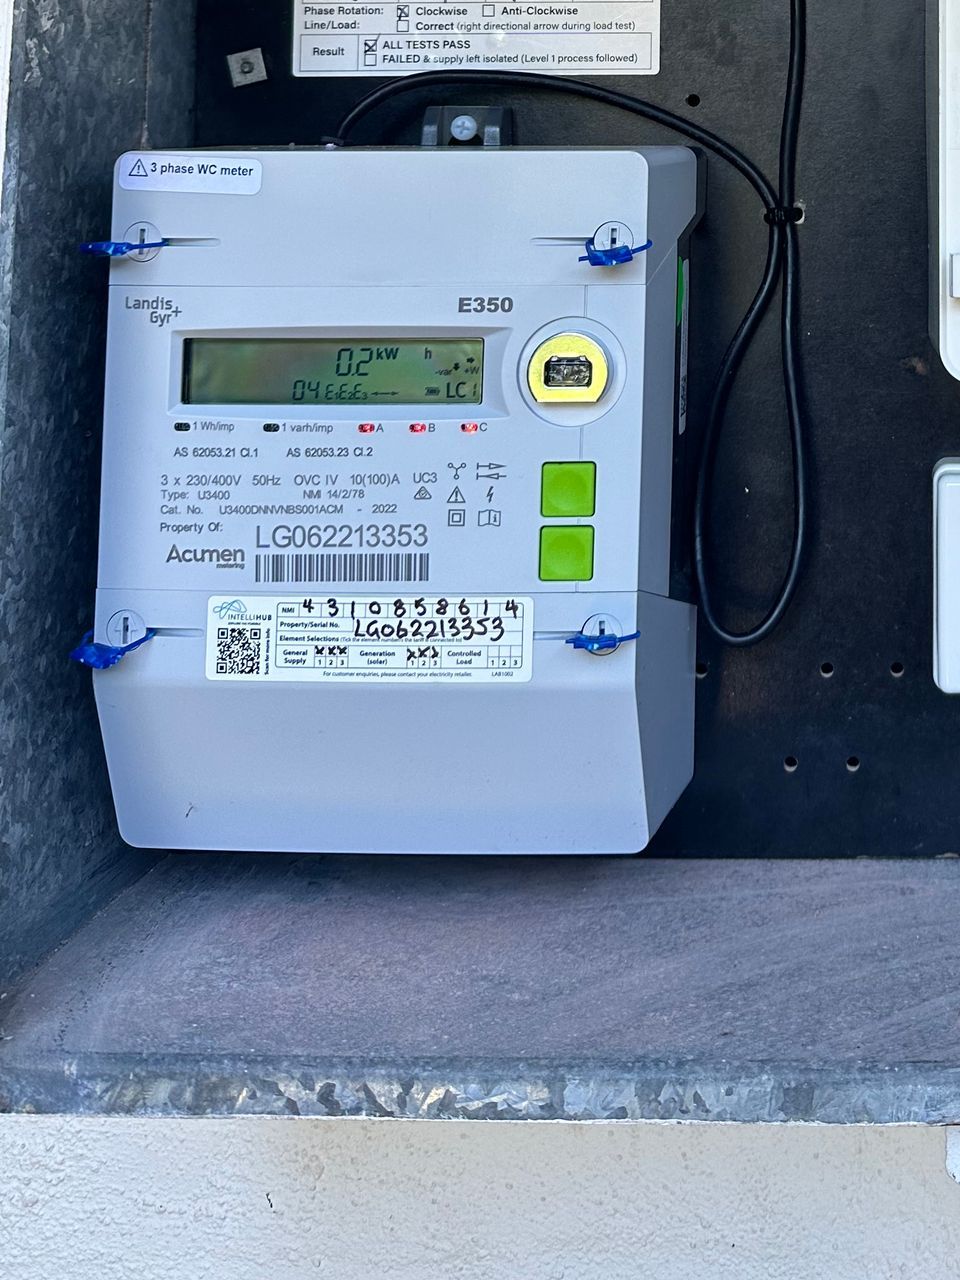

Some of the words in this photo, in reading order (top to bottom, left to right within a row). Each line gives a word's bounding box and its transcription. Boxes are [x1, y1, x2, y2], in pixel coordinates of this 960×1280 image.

[304, 7, 335, 15] Phase
[338, 7, 384, 15] Rotation:
[416, 7, 468, 15] Clockwise
[501, 6, 578, 16] Anti-Clockwise
[304, 21, 360, 30] Line/Load:
[416, 22, 454, 31] Correct
[457, 21, 481, 32] (right
[484, 22, 531, 31] directional
[561, 22, 591, 32] during
[593, 22, 612, 30] load
[615, 22, 635, 31] test)
[383, 41, 403, 49] ALL
[406, 41, 440, 49] TESTS
[443, 40, 470, 49] PASS
[313, 47, 345, 56] Result
[383, 55, 420, 64] FAILED
[434, 56, 464, 66] supply
[466, 54, 480, 64] left
[521, 55, 550, 64] (Level
[558, 55, 593, 65] process
[596, 55, 638, 63] followed)
[151, 162, 157, 172] 3
[160, 164, 193, 174] phase
[198, 165, 217, 174] WC
[220, 166, 253, 176] meter
[125, 296, 173, 310] Landis
[458, 297, 513, 313] E350
[376, 348, 399, 360] kW
[201, 422, 234, 433] Wh/imp
[290, 423, 333, 434] varh/imp
[174, 448, 188, 457] AS
[193, 448, 236, 457] 62053.21
[287, 448, 301, 457] AS
[304, 447, 350, 458] 62053.23
[161, 475, 168, 485] 3
[187, 475, 241, 486] 230/400V
[252, 476, 281, 485] 50Hz
[294, 475, 320, 485] OVC
[326, 475, 338, 485] IV
[350, 474, 400, 487] 10(100)A
[413, 472, 437, 483] UC3
[161, 490, 189, 501] Type:
[198, 491, 230, 500] U3400
[303, 490, 321, 498] NMI
[328, 489, 365, 498] 14/2/78
[187, 506, 203, 514] No.
[372, 504, 397, 513] 2022
[160, 523, 203, 534] Property
[208, 522, 223, 532] Of:
[256, 523, 428, 549] LG062213353
[166, 544, 245, 563] Acumen
